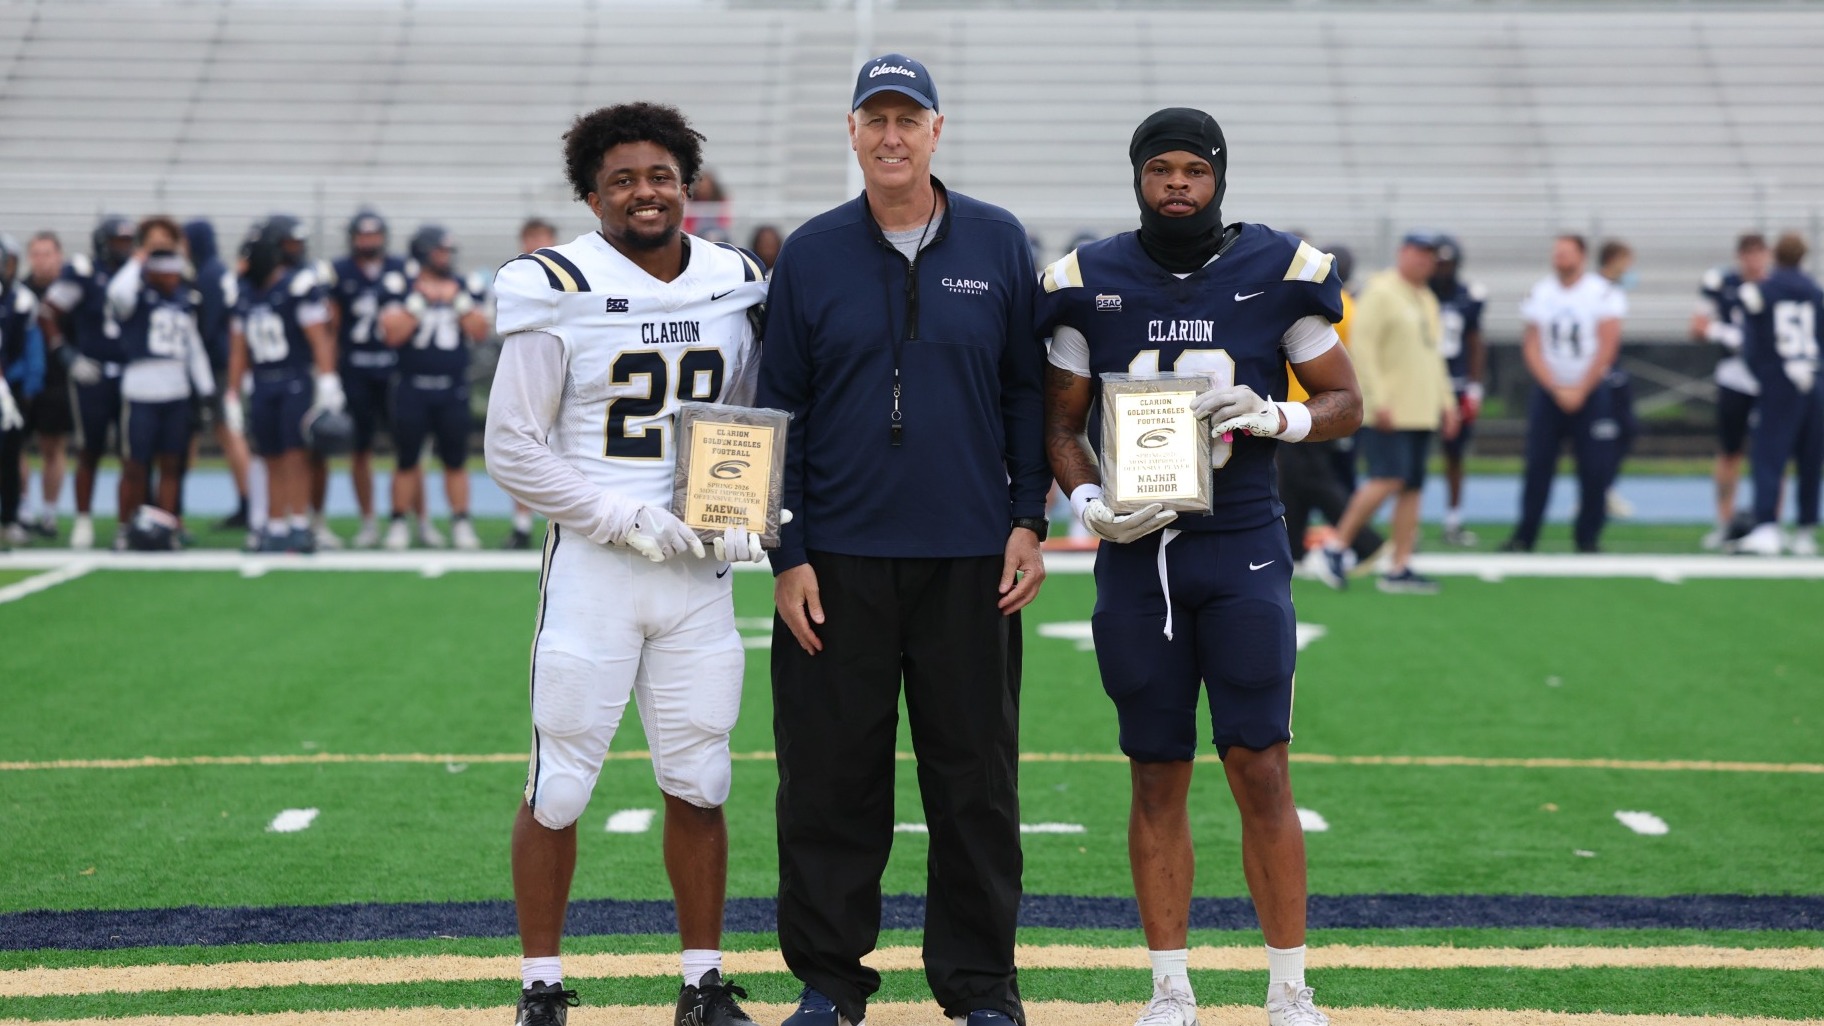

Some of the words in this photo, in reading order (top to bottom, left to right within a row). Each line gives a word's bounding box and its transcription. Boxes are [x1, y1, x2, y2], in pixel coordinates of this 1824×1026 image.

[869, 63, 916, 78] Clarion
[941, 278, 989, 290] CLARION
[1097, 299, 1121, 308] PSAC
[641, 321, 700, 344] CLARION
[1148, 320, 1214, 342] CLARION
[1157, 407, 1185, 415] EAGLES
[717, 429, 750, 438] CLARION
[703, 437, 732, 446] GOLDEN
[732, 439, 762, 449] EAGLES
[712, 447, 751, 457] FOOTBALL
[1138, 473, 1177, 483] NAJHIR
[707, 482, 733, 490] SPRING
[1137, 483, 1178, 493] KIBIDOR
[706, 503, 747, 516] KAEVON
[701, 513, 749, 526] GARDNER
